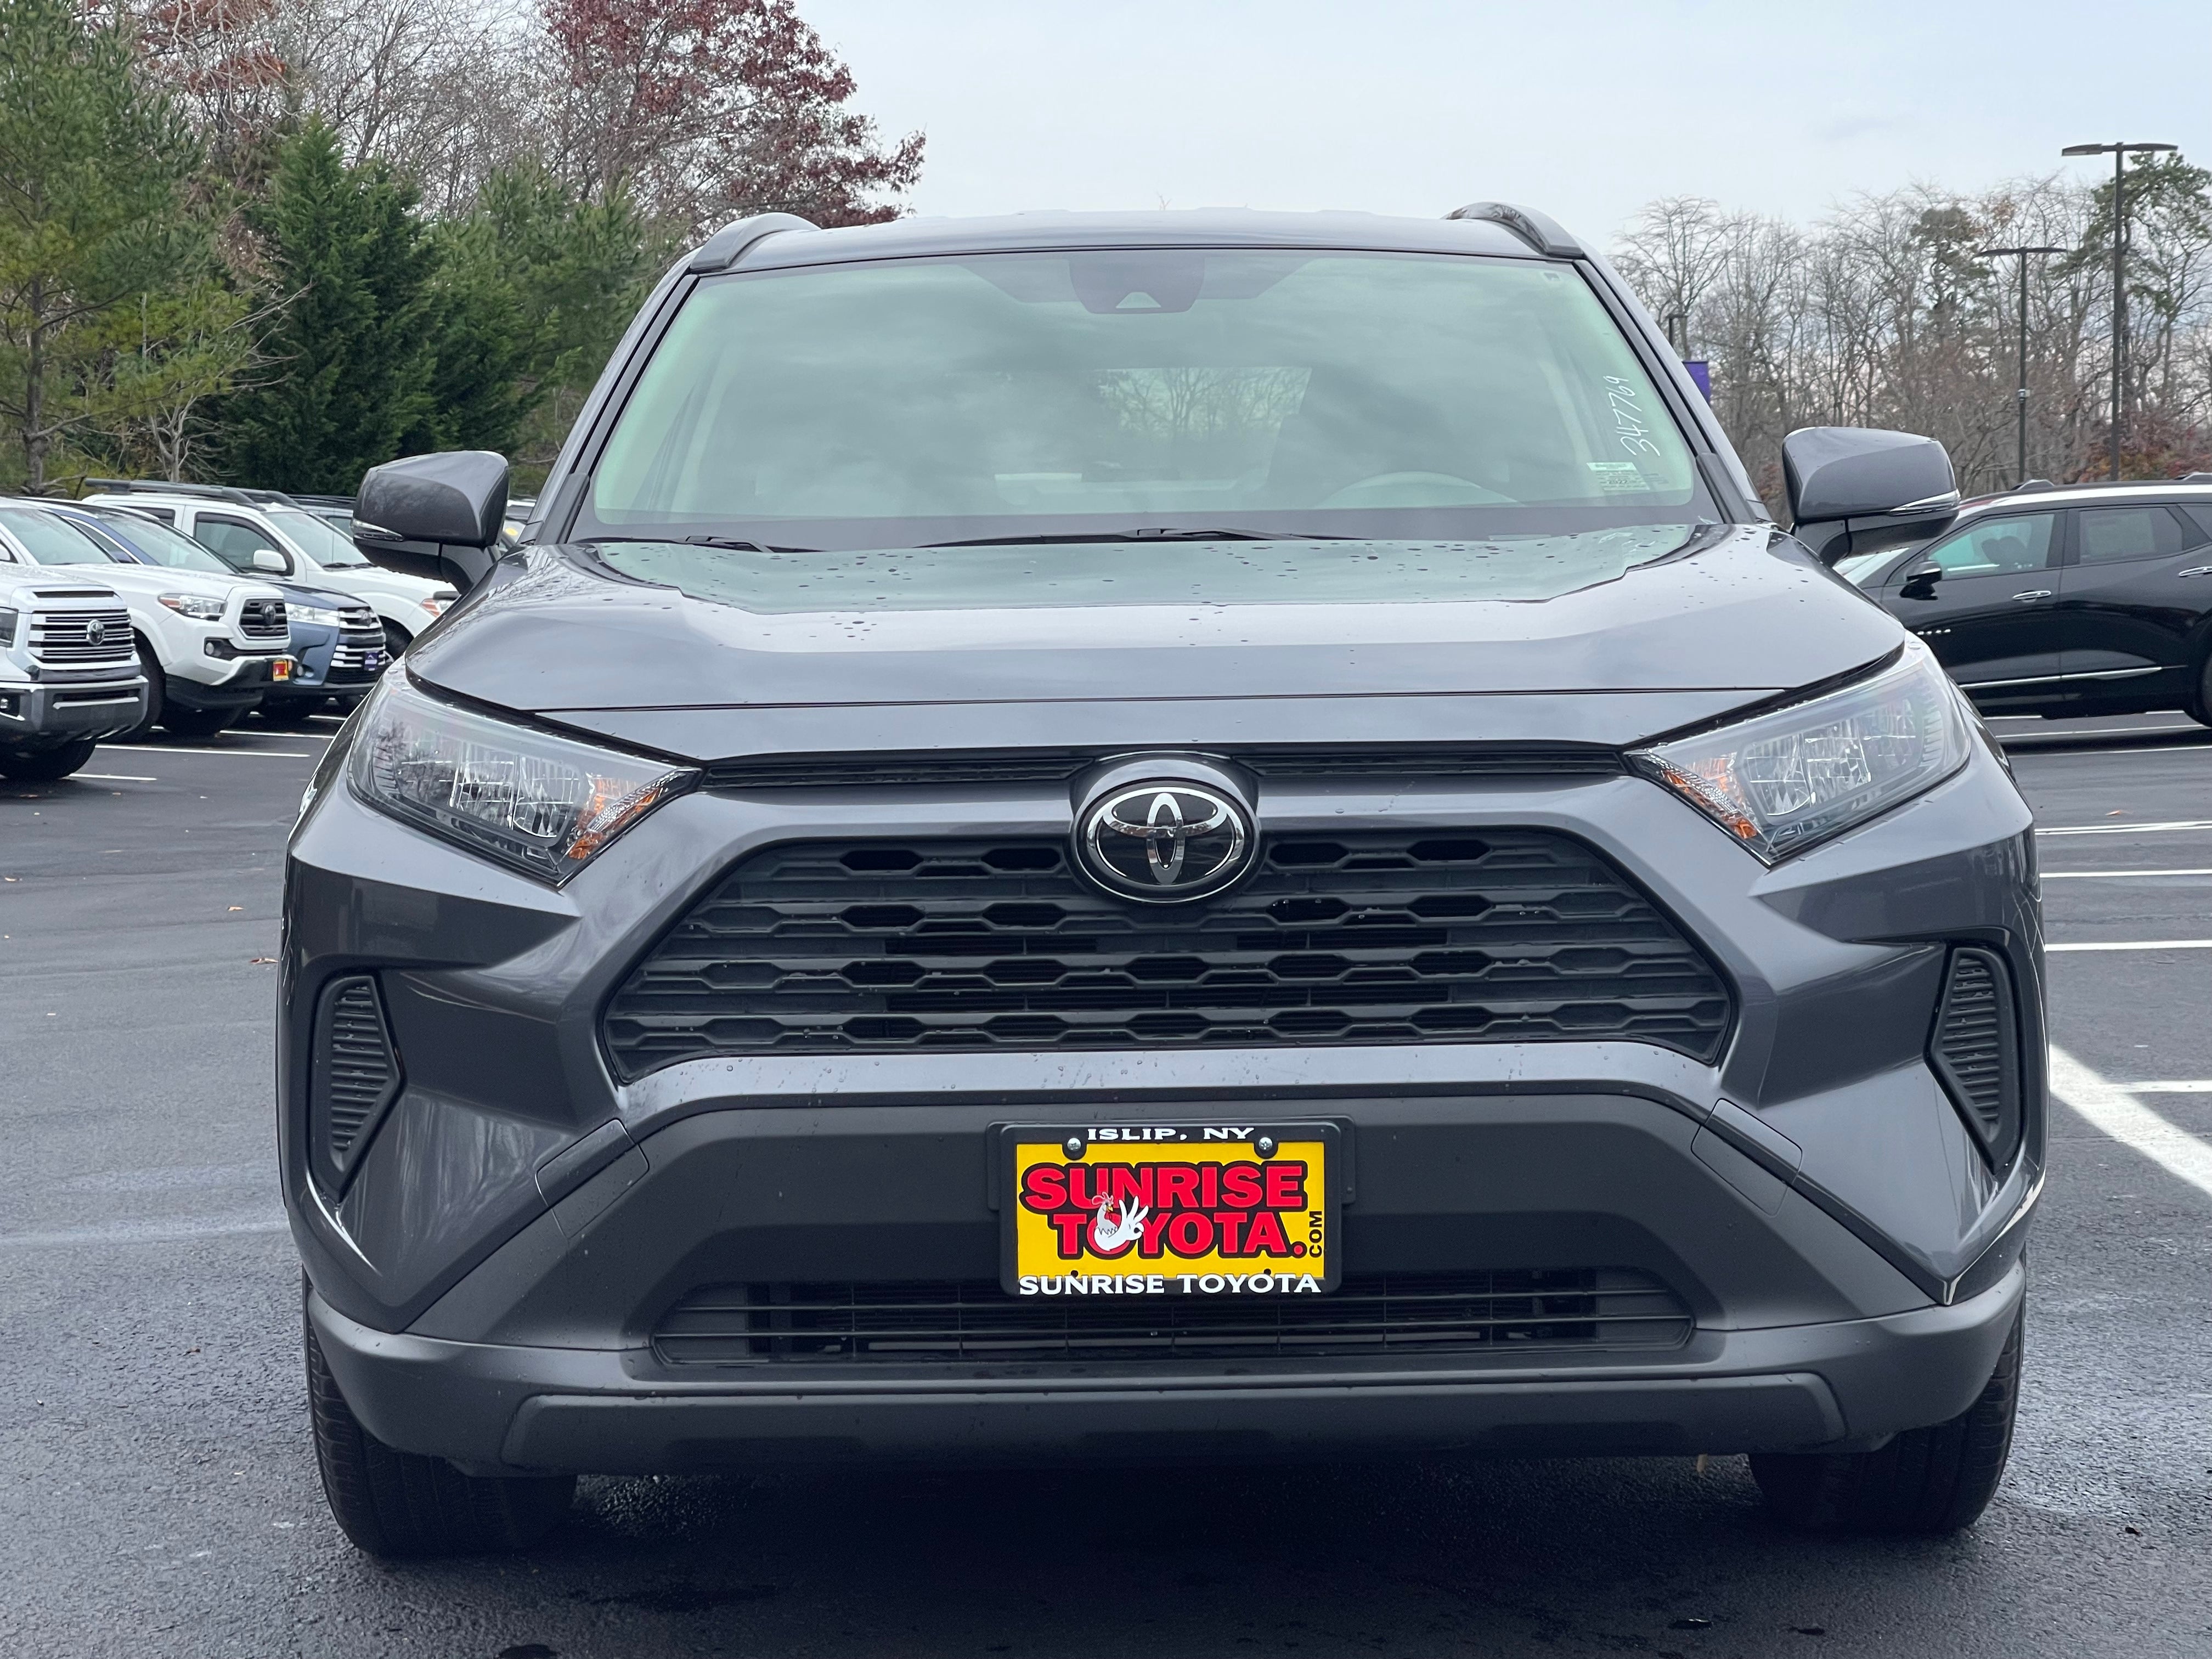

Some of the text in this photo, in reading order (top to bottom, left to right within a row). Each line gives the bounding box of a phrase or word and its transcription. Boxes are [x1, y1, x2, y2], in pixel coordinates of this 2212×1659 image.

[1087, 1127, 1254, 1141] ISLIP, NY
[1024, 1164, 1304, 1209] SUNRISE
[1019, 1274, 1321, 1295] SUNRISE TOYOTA
